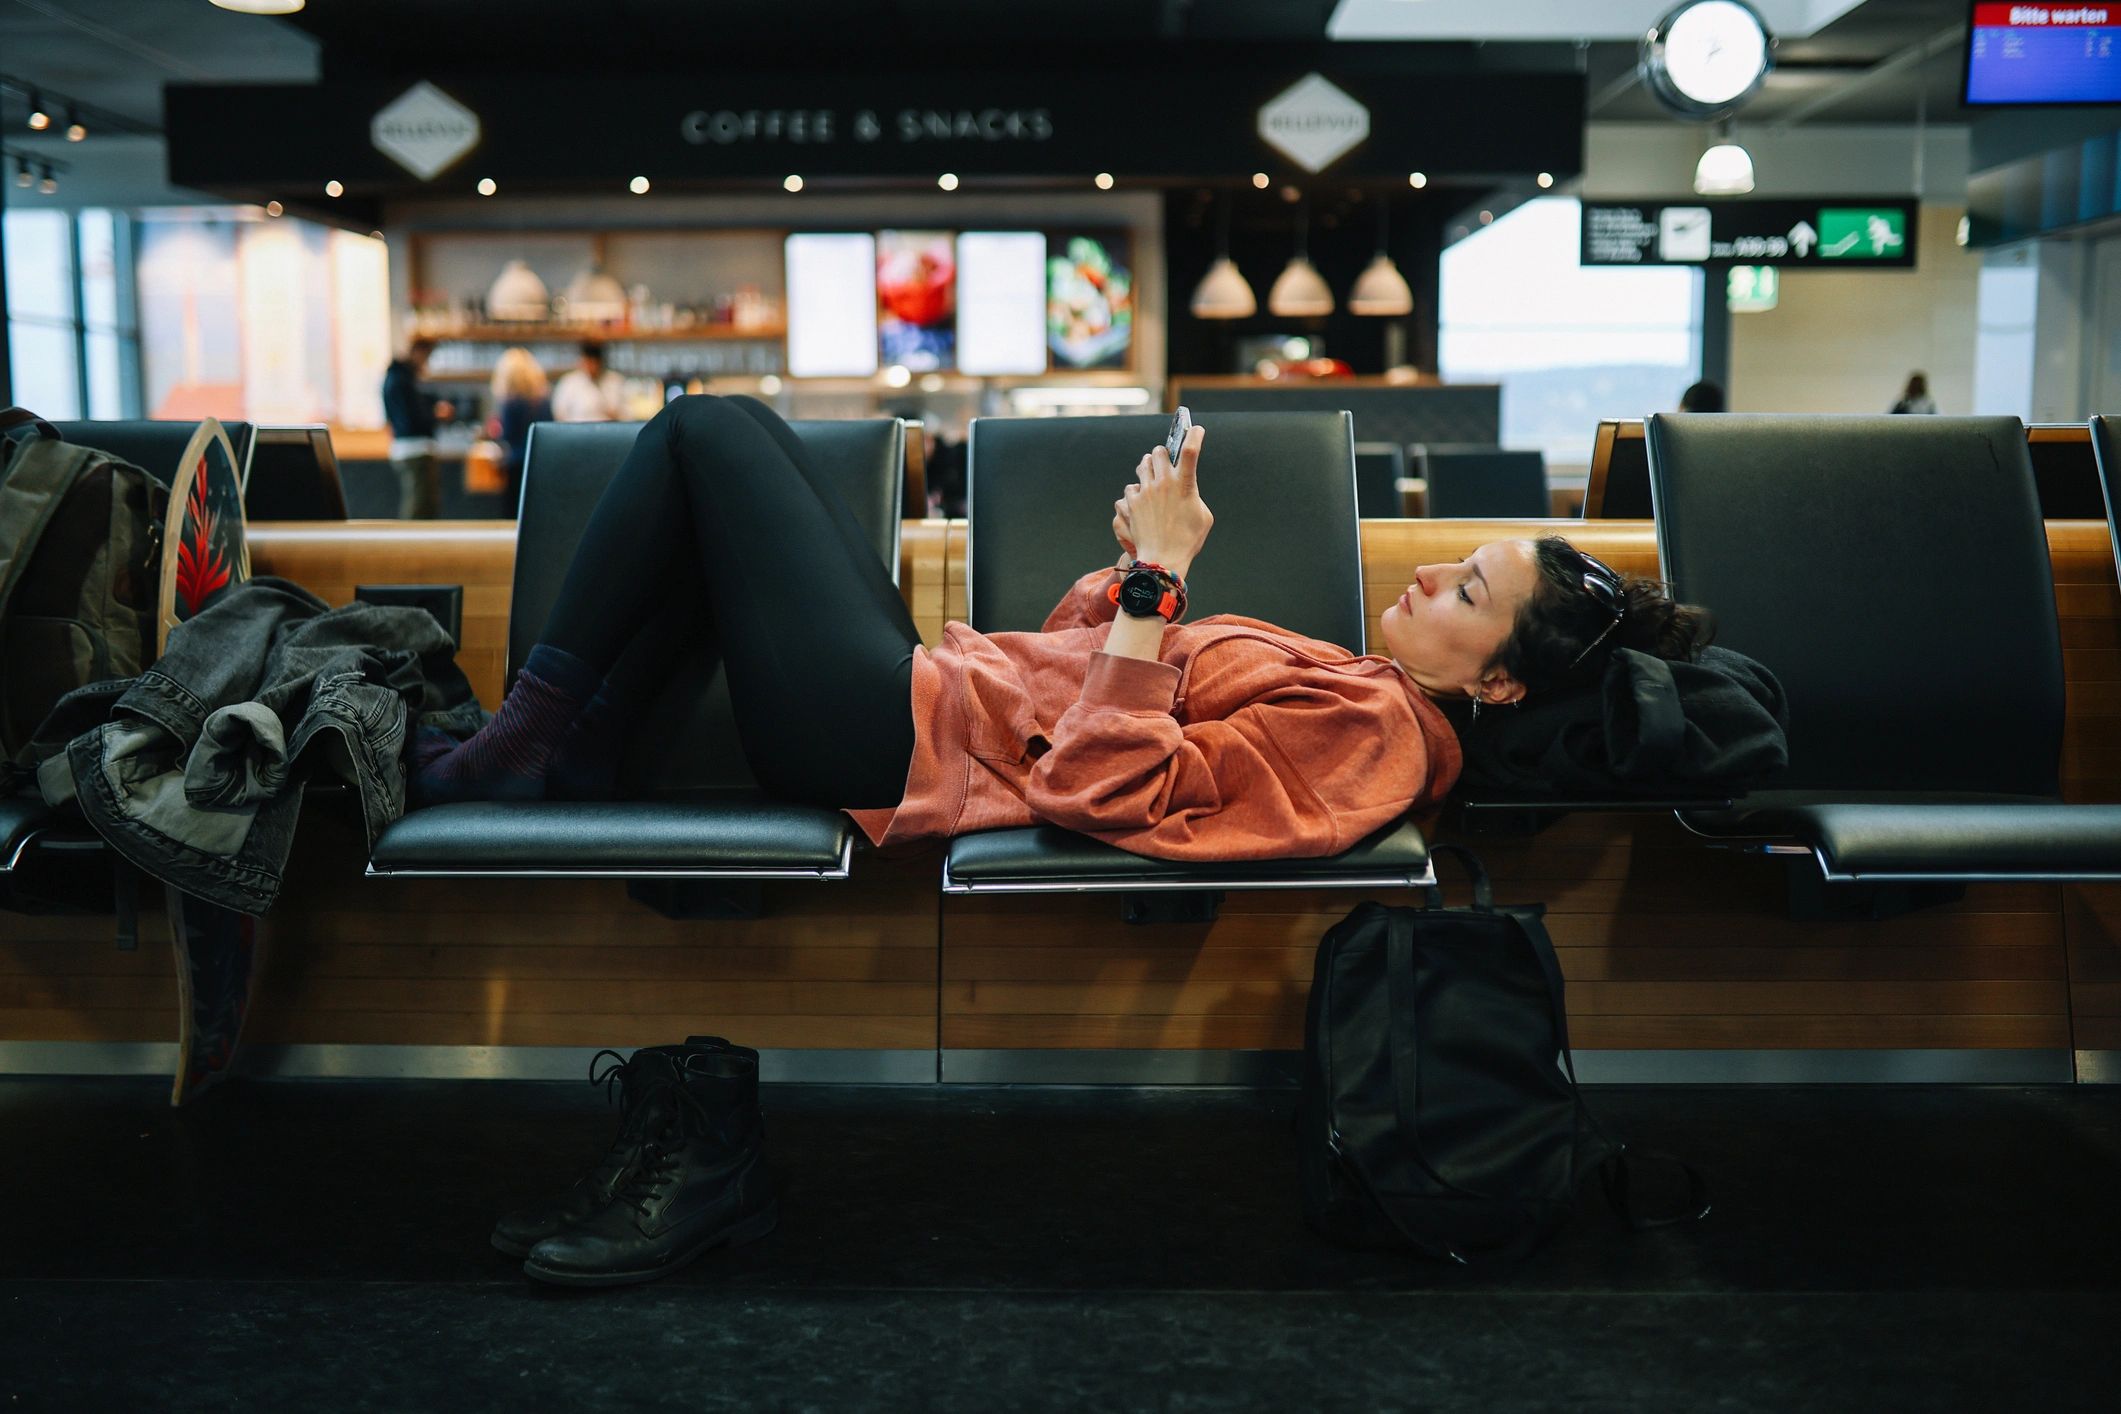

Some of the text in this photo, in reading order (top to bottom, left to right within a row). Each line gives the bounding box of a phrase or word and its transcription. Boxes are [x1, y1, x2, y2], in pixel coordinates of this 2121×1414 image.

[2009, 5, 2107, 25] Bitte warten
[681, 108, 1054, 145] COFFEE & SNACKS
